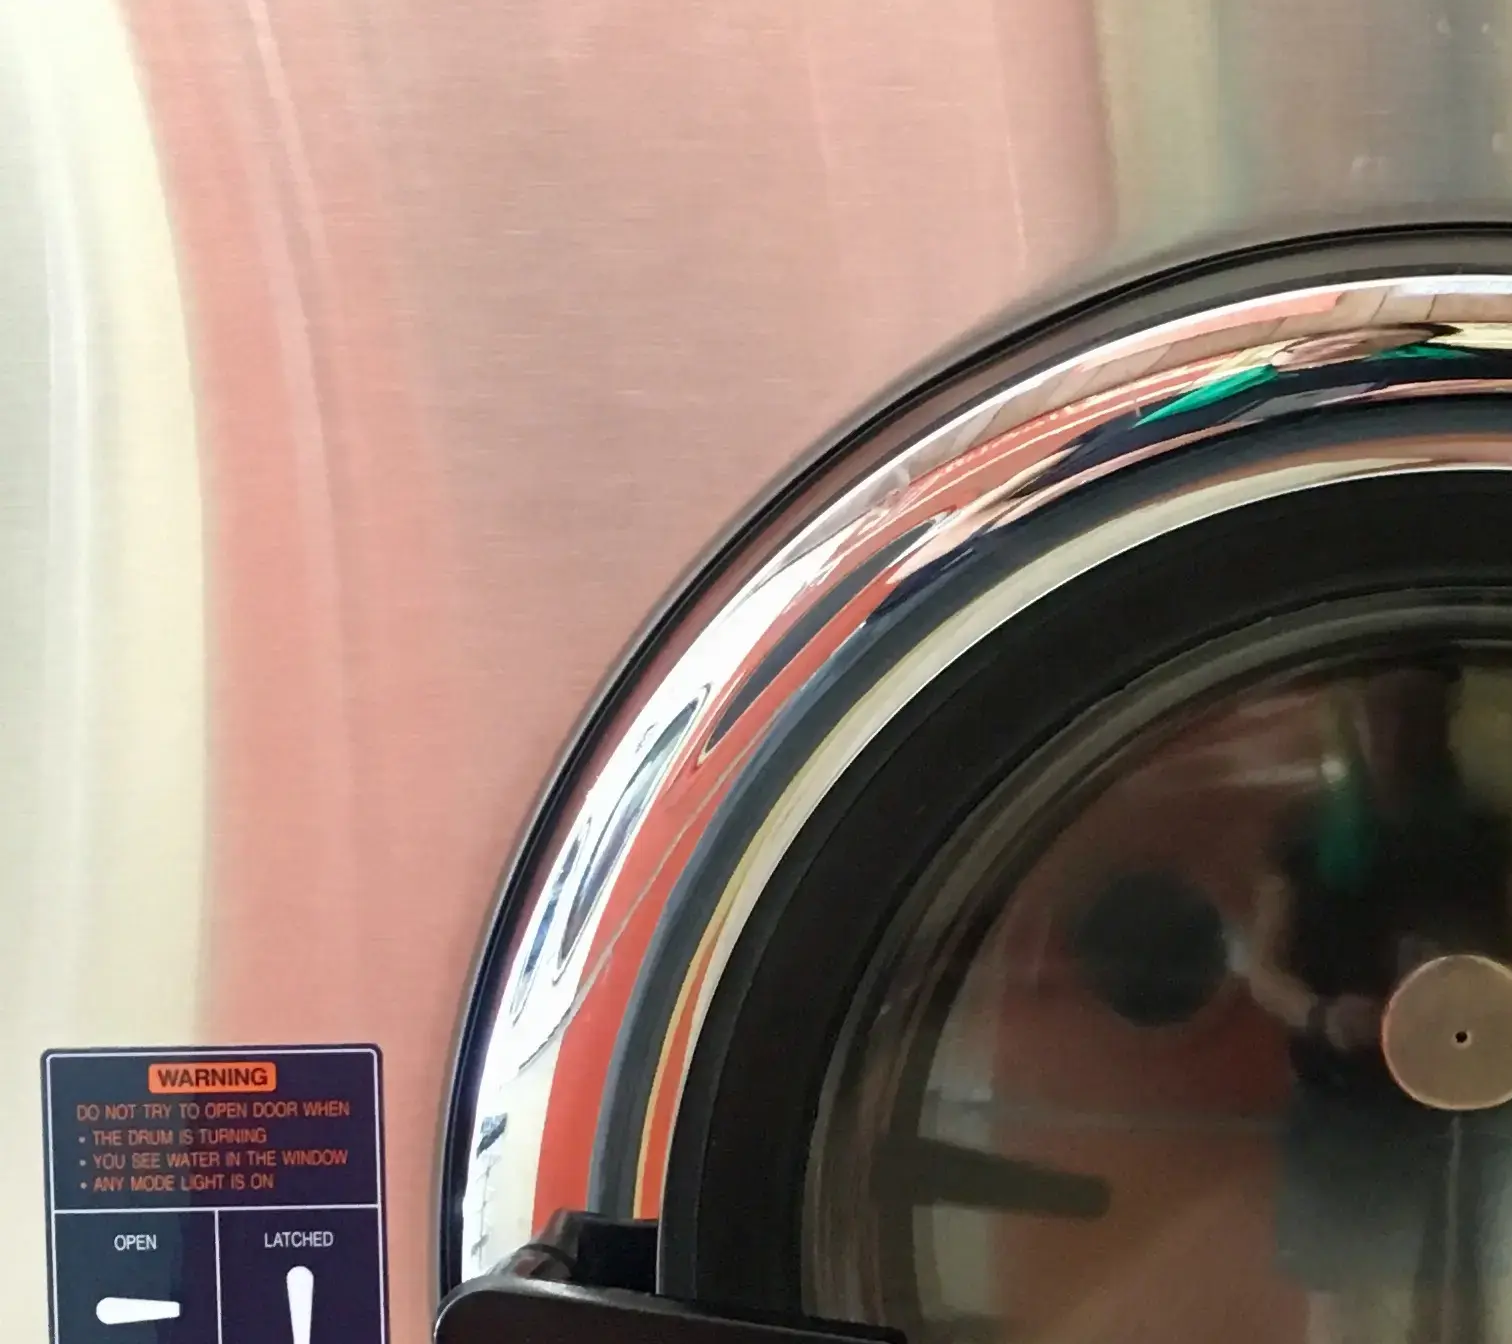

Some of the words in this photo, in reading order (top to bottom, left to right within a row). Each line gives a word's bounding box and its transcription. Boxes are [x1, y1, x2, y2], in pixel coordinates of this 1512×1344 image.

[156, 1067, 268, 1088] WARNING
[77, 1106, 100, 1121] DO
[105, 1105, 137, 1121] NOT
[144, 1105, 172, 1120] TRY
[179, 1105, 200, 1120] TO
[205, 1104, 248, 1119] OPEN
[253, 1103, 298, 1119] DOOR
[302, 1103, 350, 1118] WHEN
[93, 1131, 122, 1146] THE
[128, 1130, 173, 1146] DRUM
[179, 1130, 193, 1145] IS
[199, 1129, 267, 1145] TURNING
[94, 1154, 126, 1170] YOU
[132, 1153, 161, 1169] SEE
[166, 1152, 220, 1169] WATER
[226, 1152, 241, 1168] IN
[248, 1151, 276, 1168] THE
[282, 1150, 348, 1167] WINDOW
[93, 1177, 123, 1192] ANY
[131, 1176, 174, 1191] MODE
[181, 1175, 224, 1191] LIGHT
[231, 1175, 245, 1190] IS
[251, 1174, 274, 1190] ON
[113, 1234, 157, 1251] OPEN
[264, 1231, 334, 1248] LATCHED
